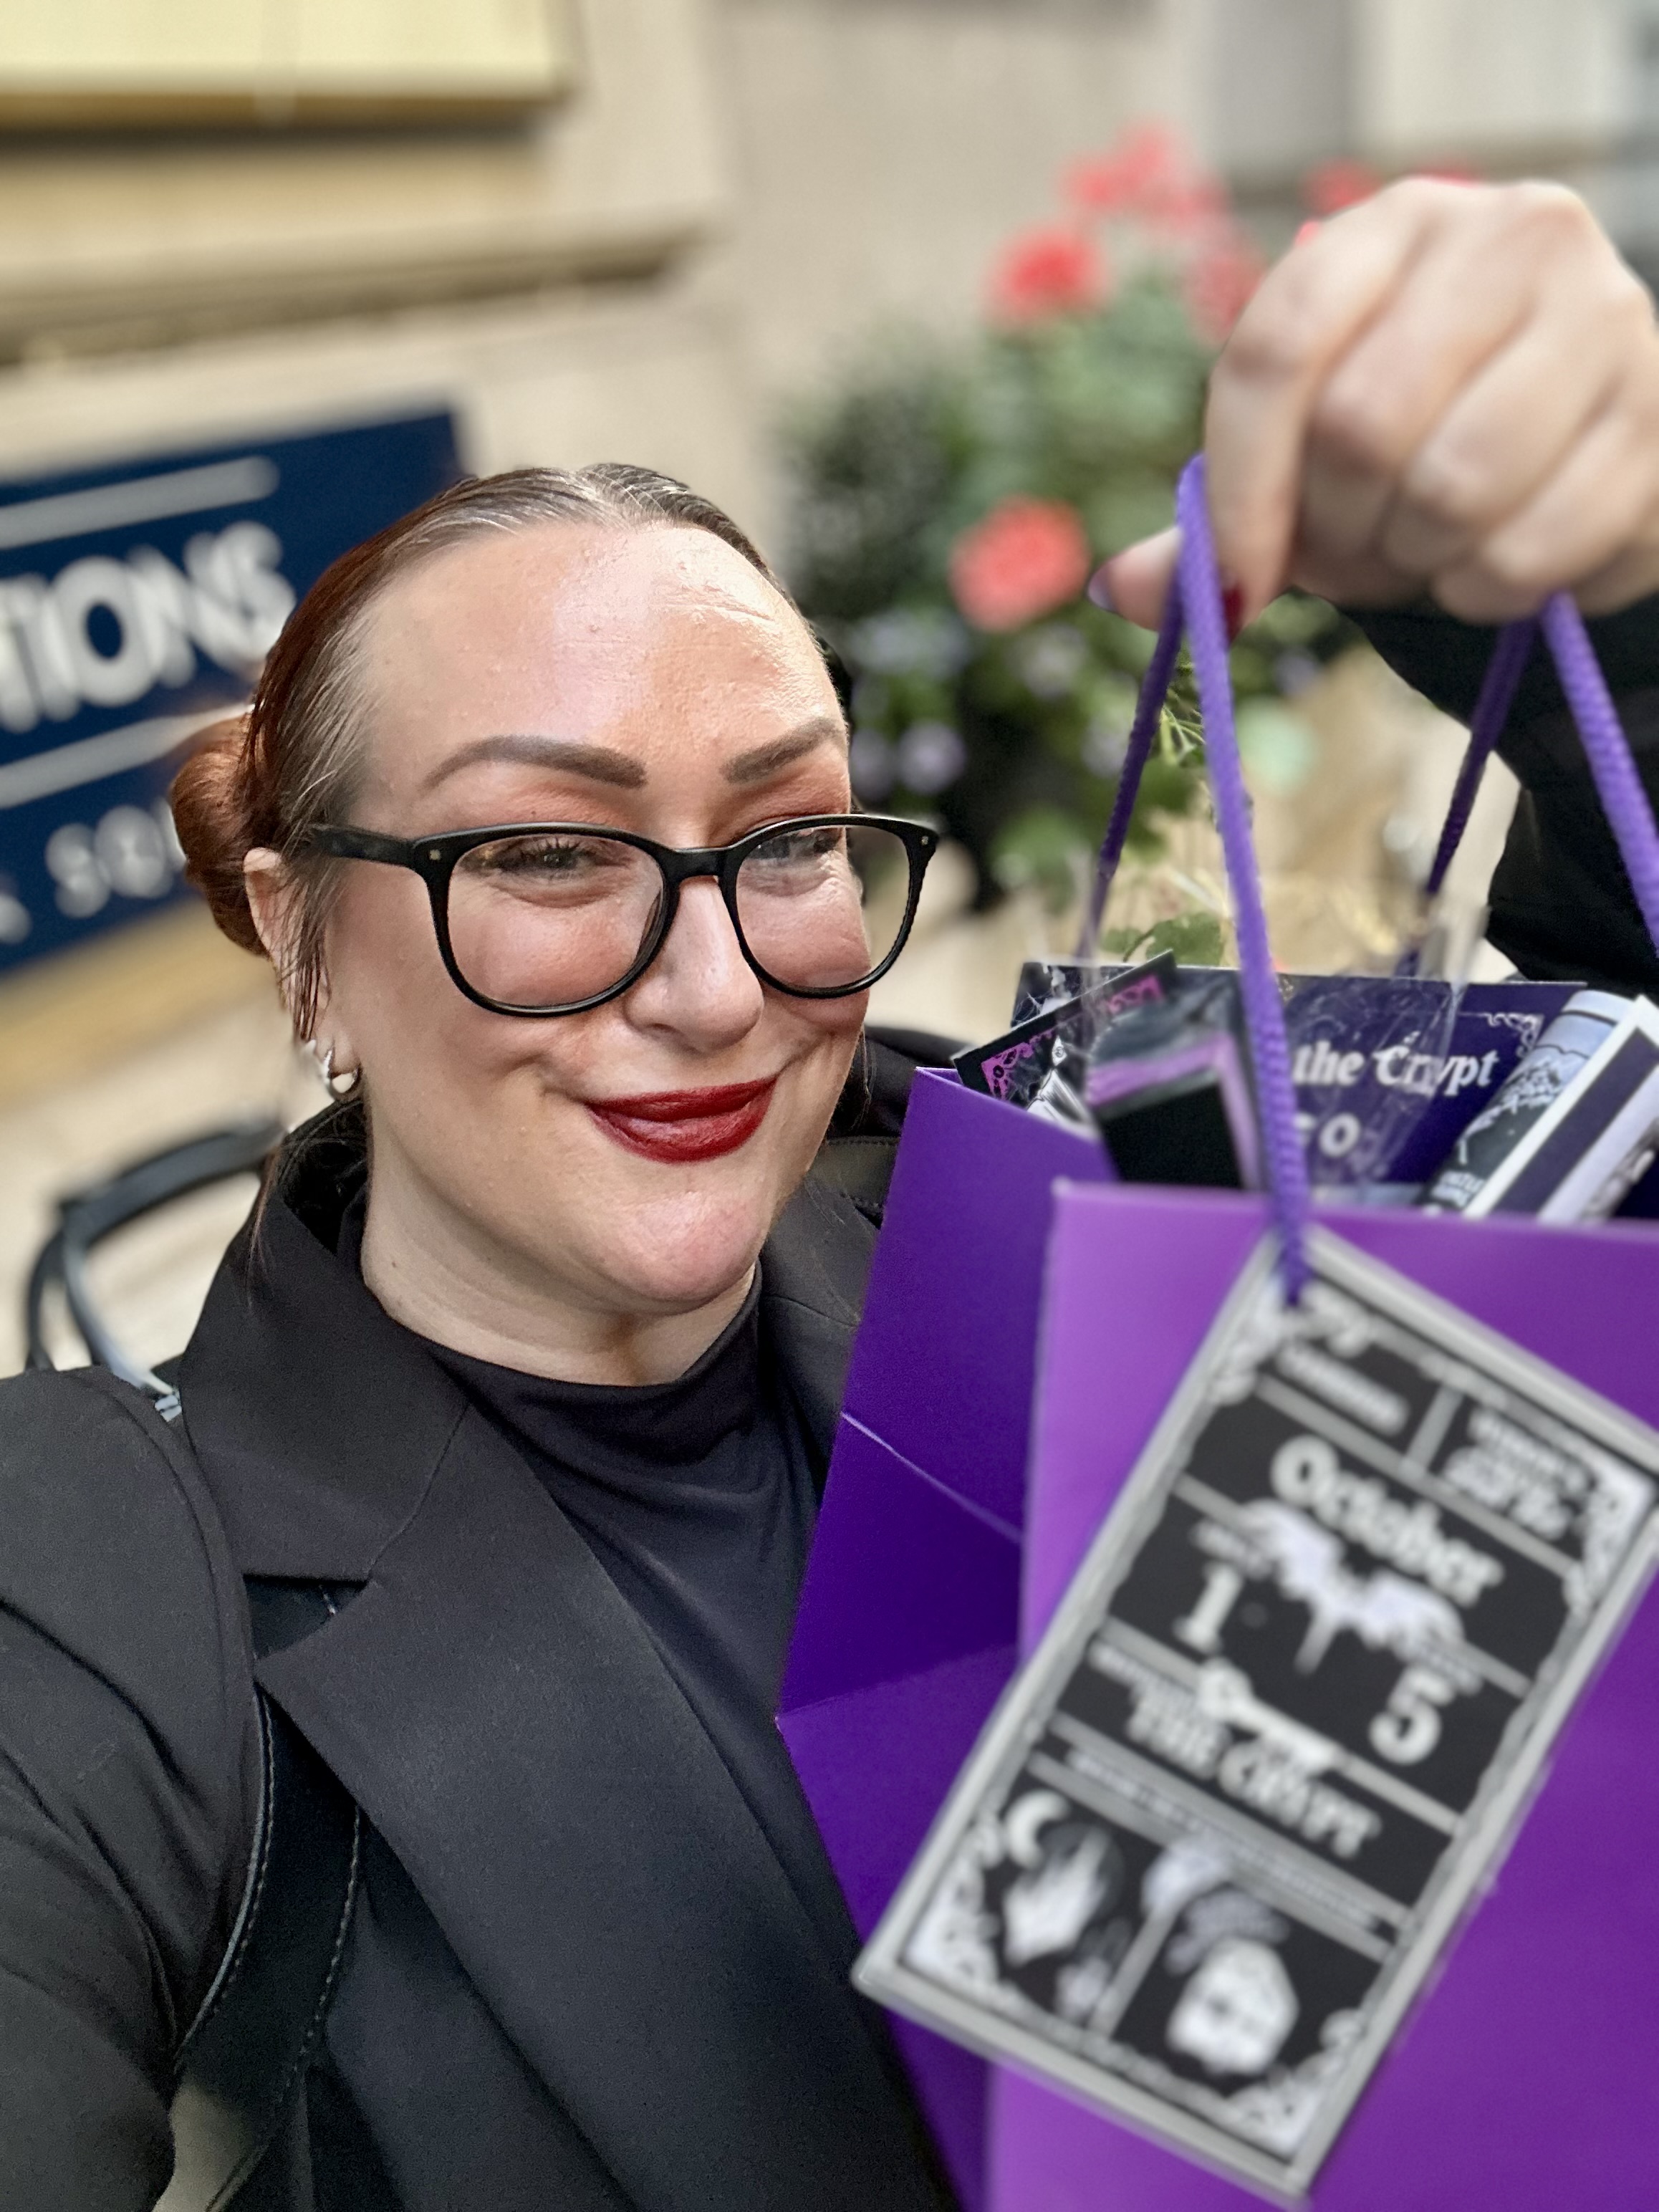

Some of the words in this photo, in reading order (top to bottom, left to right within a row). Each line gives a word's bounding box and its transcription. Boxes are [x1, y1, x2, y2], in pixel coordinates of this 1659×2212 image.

[1291, 1039, 1365, 1086] the
[1370, 1043, 1500, 1096] Crypt
[1271, 1434, 1504, 1607] October
[1173, 1562, 1244, 1649] 1
[1370, 1666, 1456, 1765] 5
